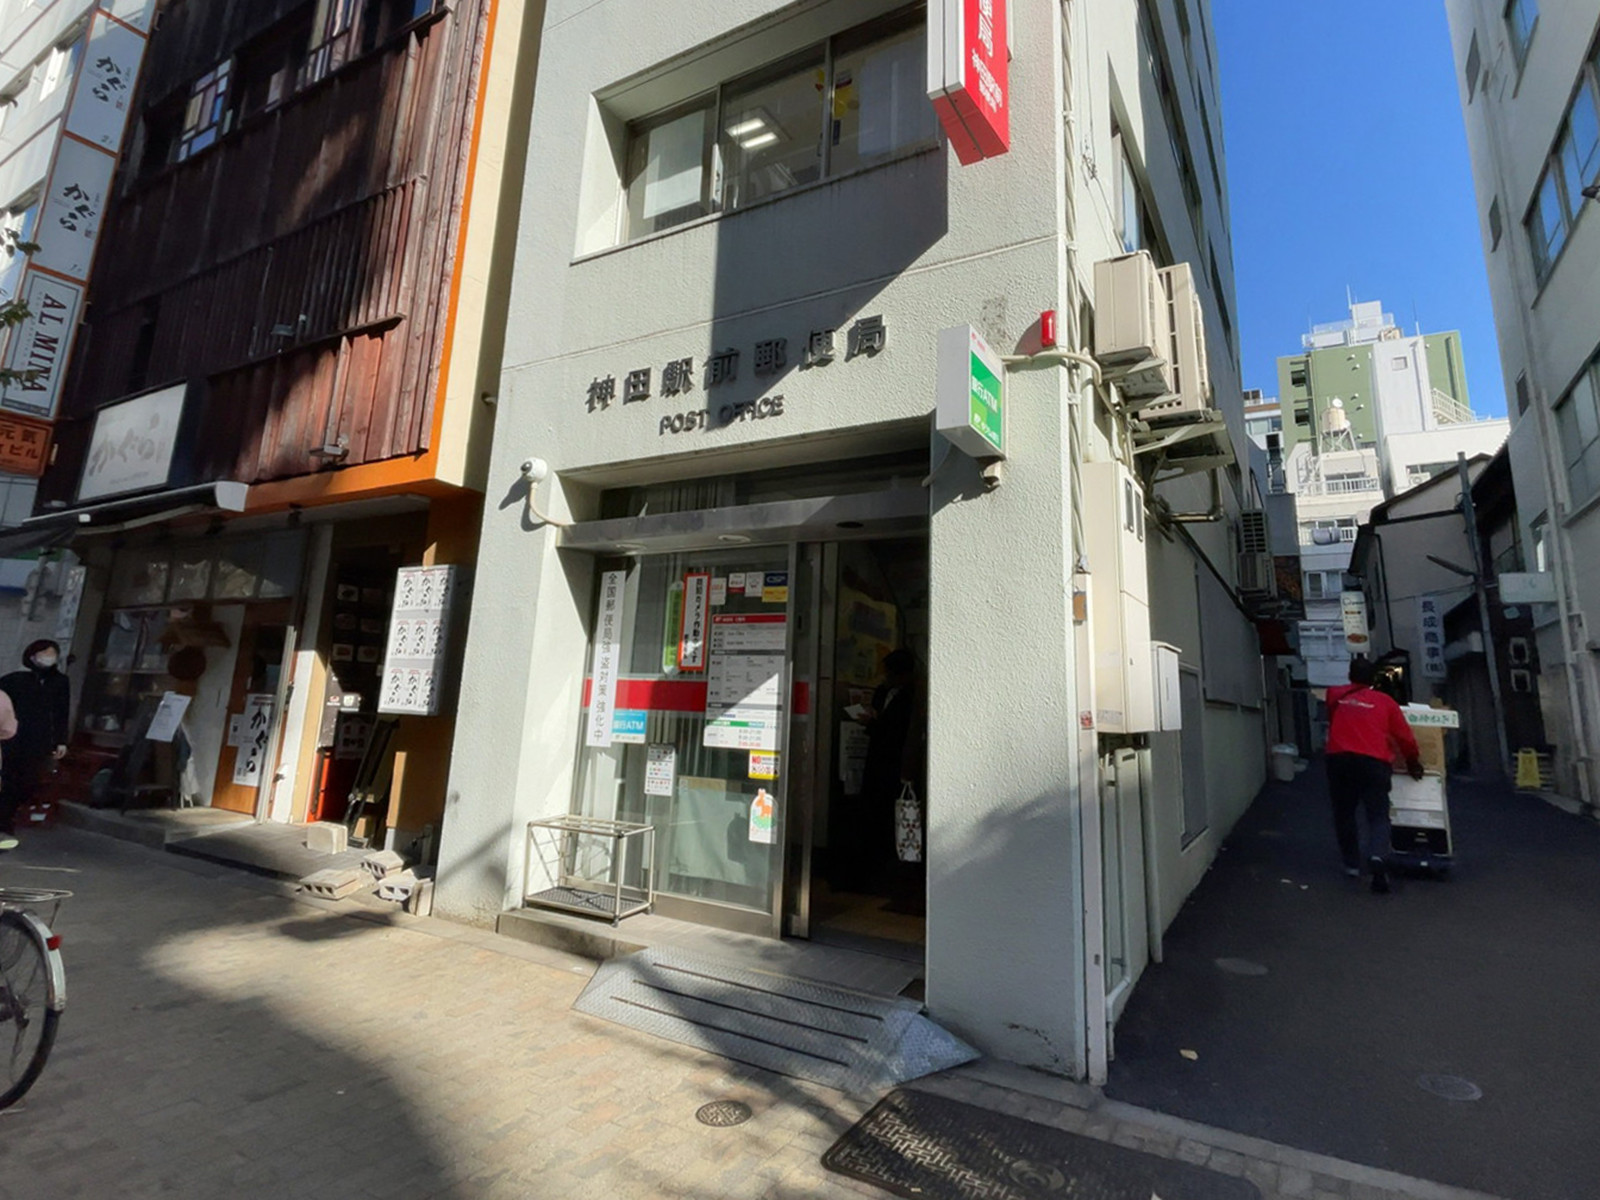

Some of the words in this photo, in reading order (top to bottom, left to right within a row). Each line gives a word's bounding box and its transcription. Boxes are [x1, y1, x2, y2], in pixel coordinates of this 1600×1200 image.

[38, 293, 67, 325] AL
[21, 331, 59, 392] MINA
[586, 314, 886, 414] 神田駅前郵便局
[659, 408, 711, 437] POST
[718, 394, 785, 425] OFFICE
